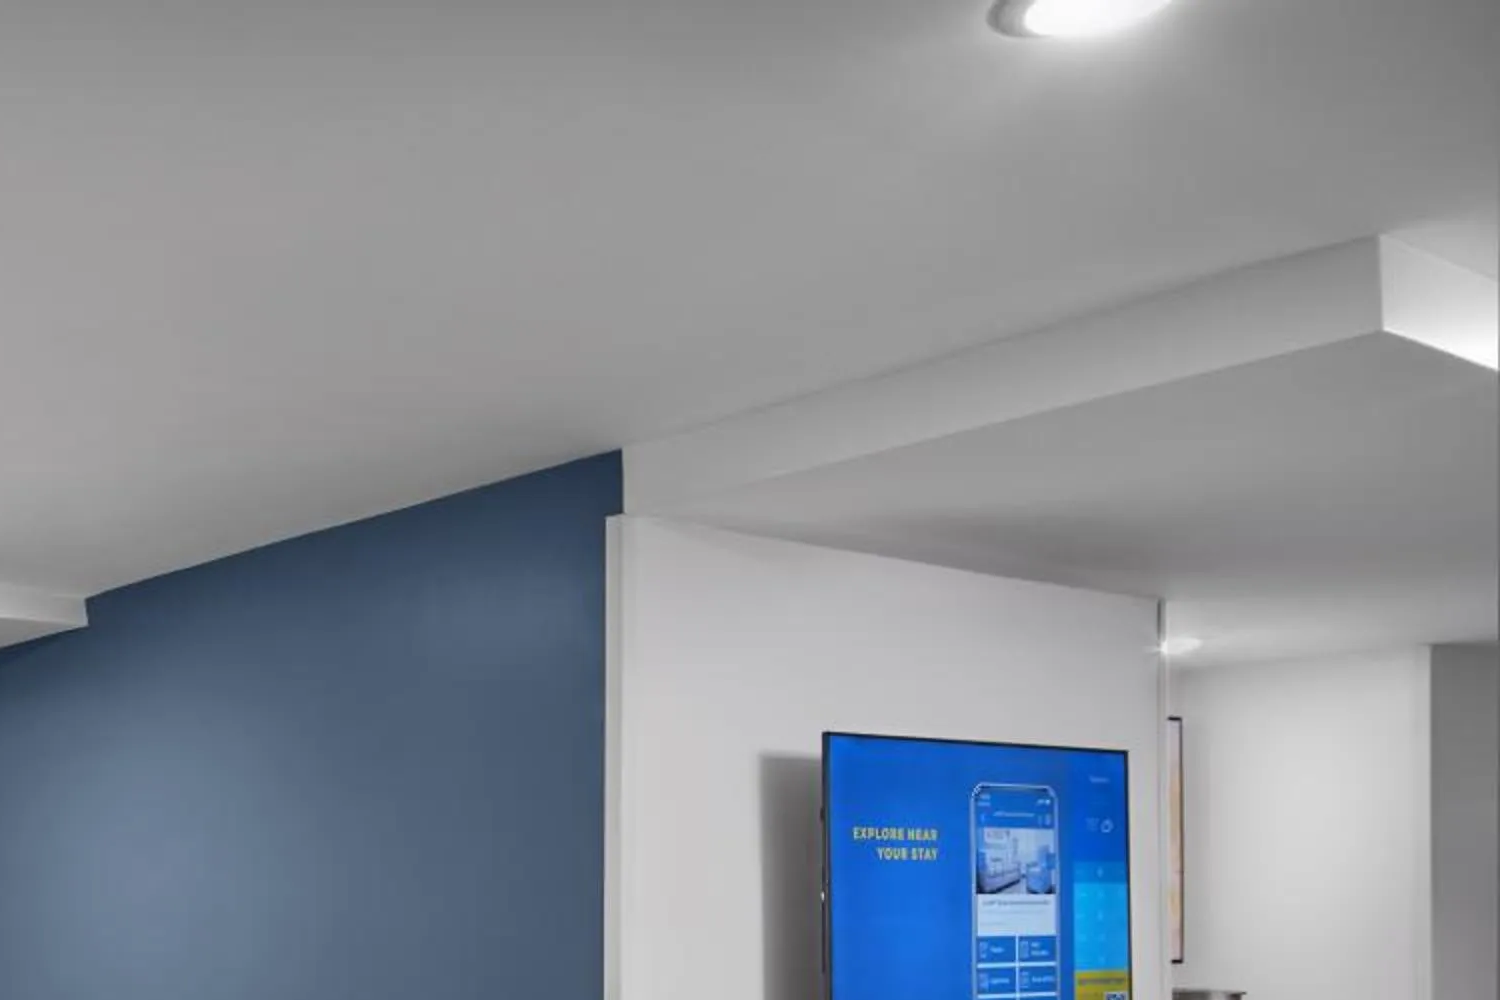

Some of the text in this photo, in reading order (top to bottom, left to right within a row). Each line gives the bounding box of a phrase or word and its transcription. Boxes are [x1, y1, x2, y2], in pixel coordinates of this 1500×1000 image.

[853, 826, 939, 841] EXPLORE NEAR
[876, 847, 938, 861] YOUR STAY
